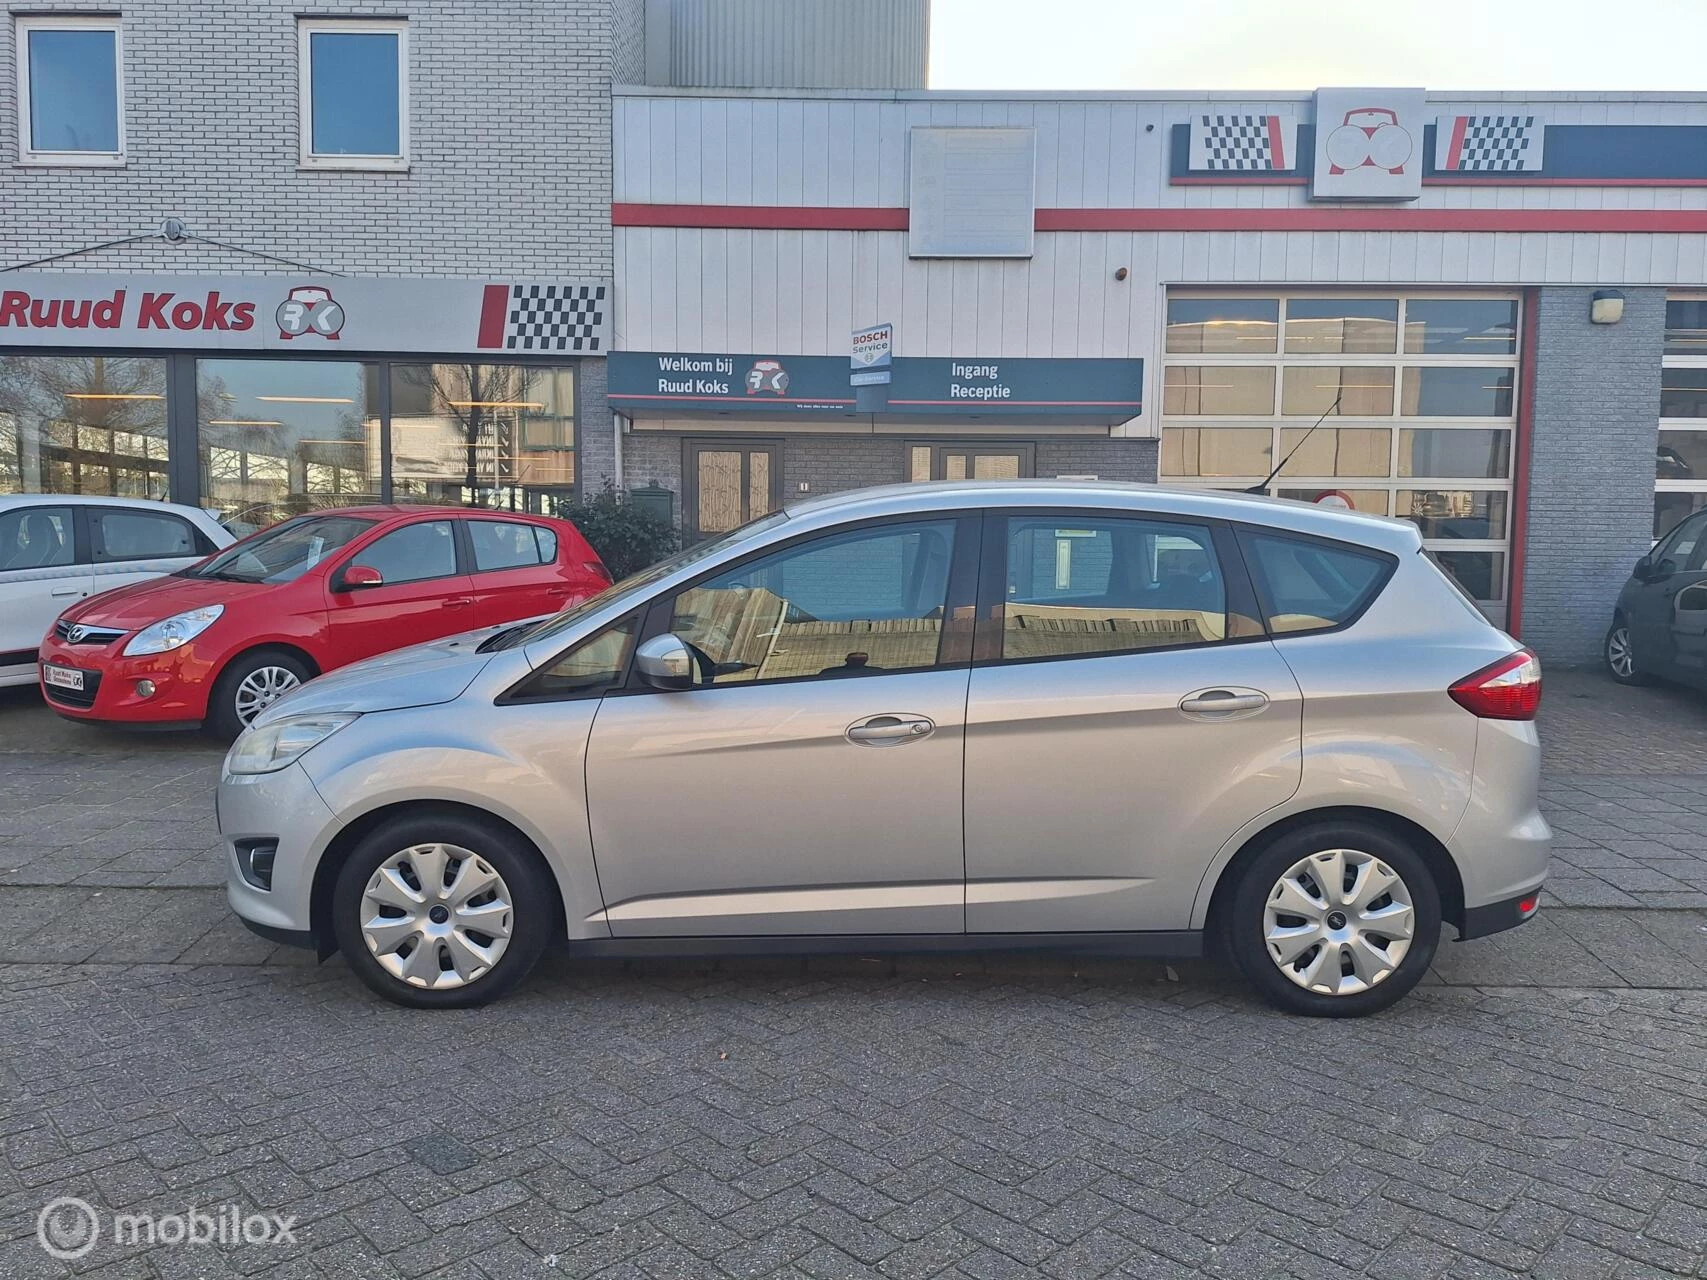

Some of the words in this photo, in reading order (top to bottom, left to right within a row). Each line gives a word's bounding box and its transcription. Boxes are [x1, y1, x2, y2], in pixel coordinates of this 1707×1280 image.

[0, 289, 126, 329] Ruud
[137, 290, 256, 331] Koks
[853, 330, 888, 345] BOSCH
[852, 342, 888, 354] Service
[658, 357, 713, 372] Welkom
[716, 358, 733, 376] bij
[951, 362, 999, 380] Ingang
[658, 378, 693, 393] Ruud
[696, 379, 729, 394] Koks
[950, 383, 1011, 401] Receptie
